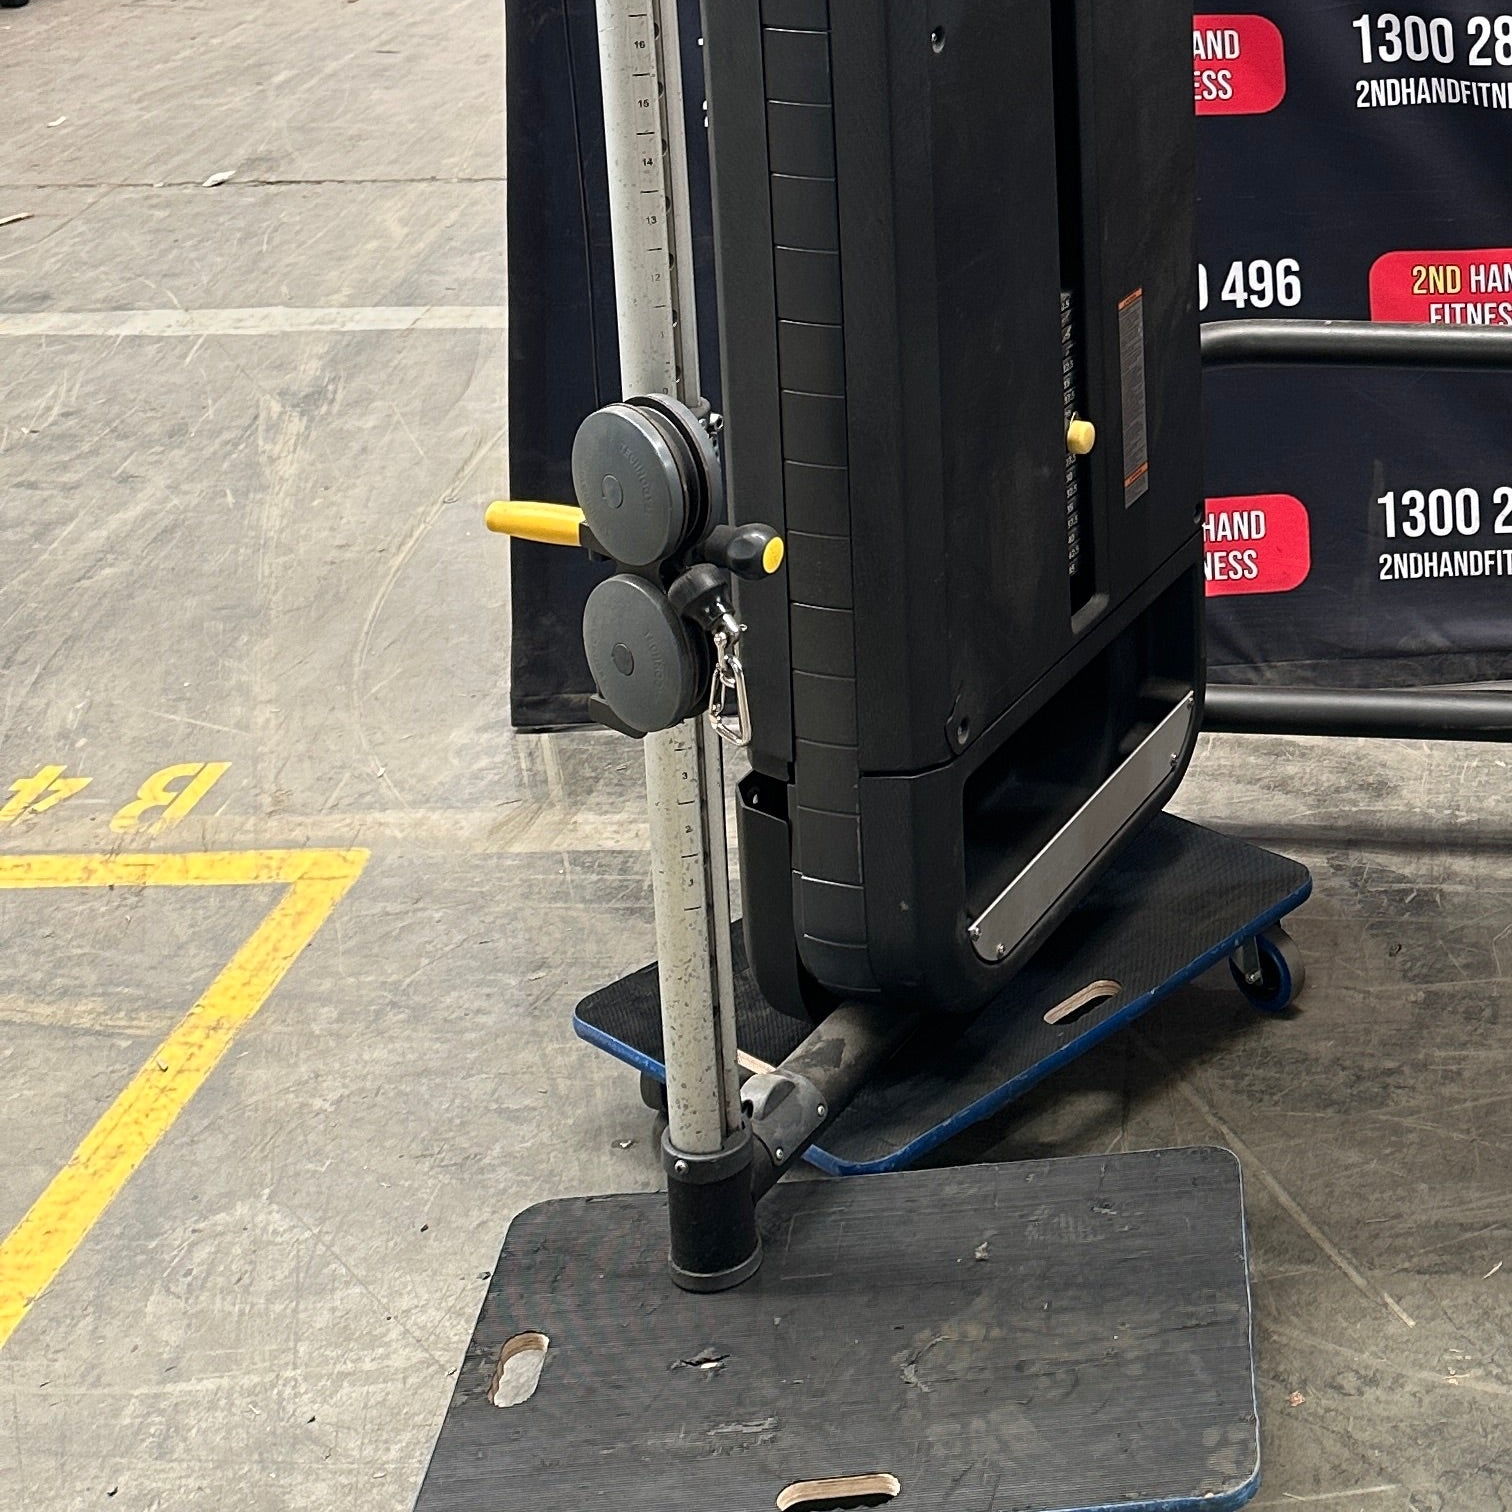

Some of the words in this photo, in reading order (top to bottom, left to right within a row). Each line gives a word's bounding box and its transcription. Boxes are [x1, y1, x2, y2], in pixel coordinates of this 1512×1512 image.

[634, 41, 646, 49] 16
[1194, 29, 1240, 60] AND
[1352, 14, 1455, 64] 1300
[638, 100, 650, 108] 15
[642, 158, 654, 167] 14
[646, 216, 657, 224] 13
[1221, 258, 1302, 309] 496
[1412, 264, 1461, 295] 2ND
[1377, 487, 1480, 539] 1300
